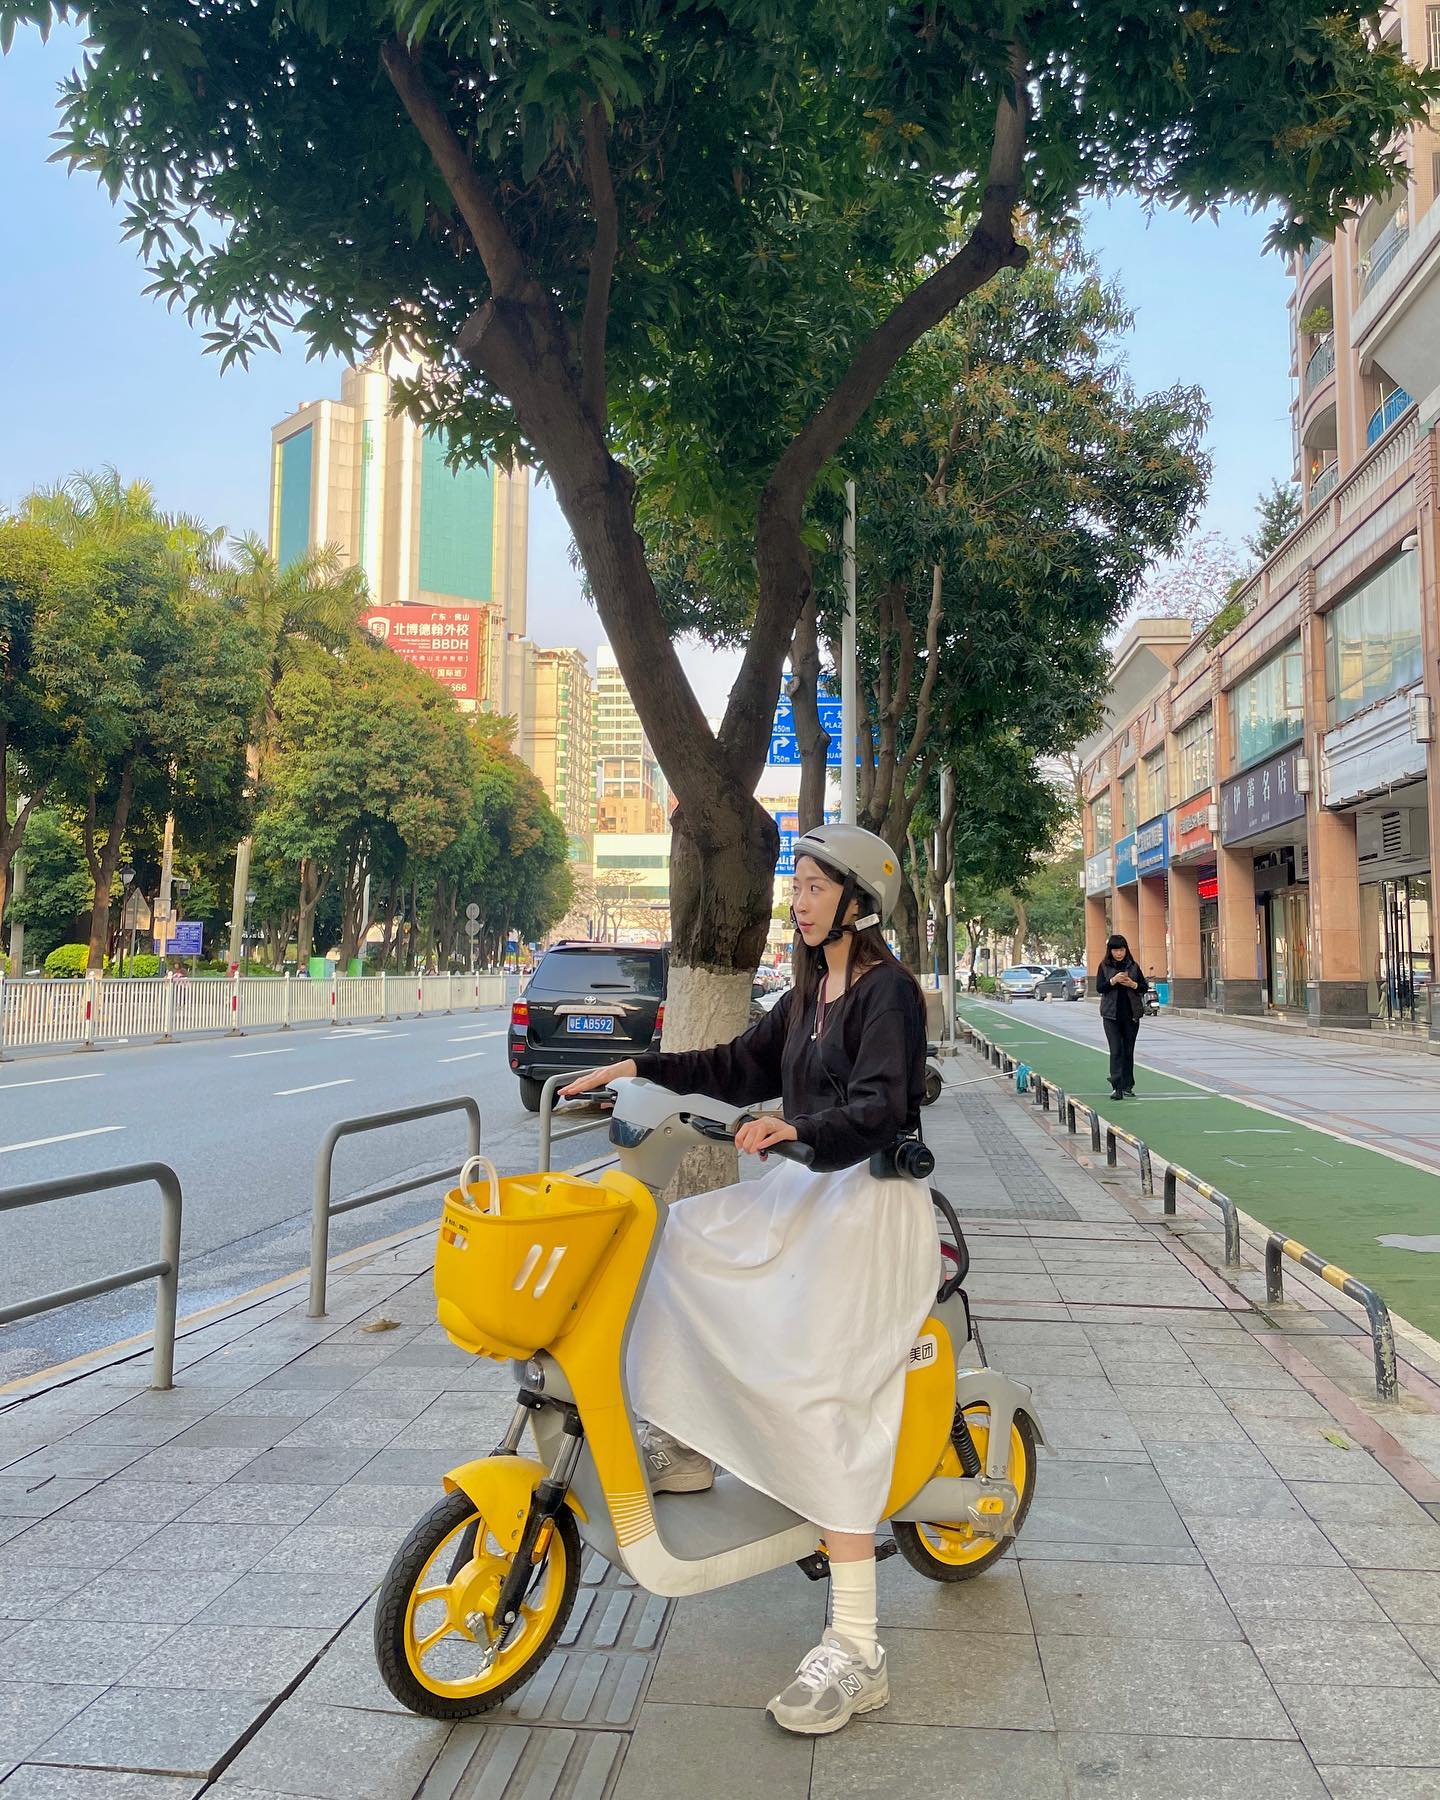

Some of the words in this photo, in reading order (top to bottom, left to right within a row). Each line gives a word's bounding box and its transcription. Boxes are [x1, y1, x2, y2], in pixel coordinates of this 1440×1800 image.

[432, 638, 469, 650] BBDH
[772, 725, 791, 733] 450m
[773, 755, 790, 763] 750m
[910, 1343, 933, 1363] 美团
[648, 1450, 672, 1472] N
[839, 1673, 863, 1697] N
